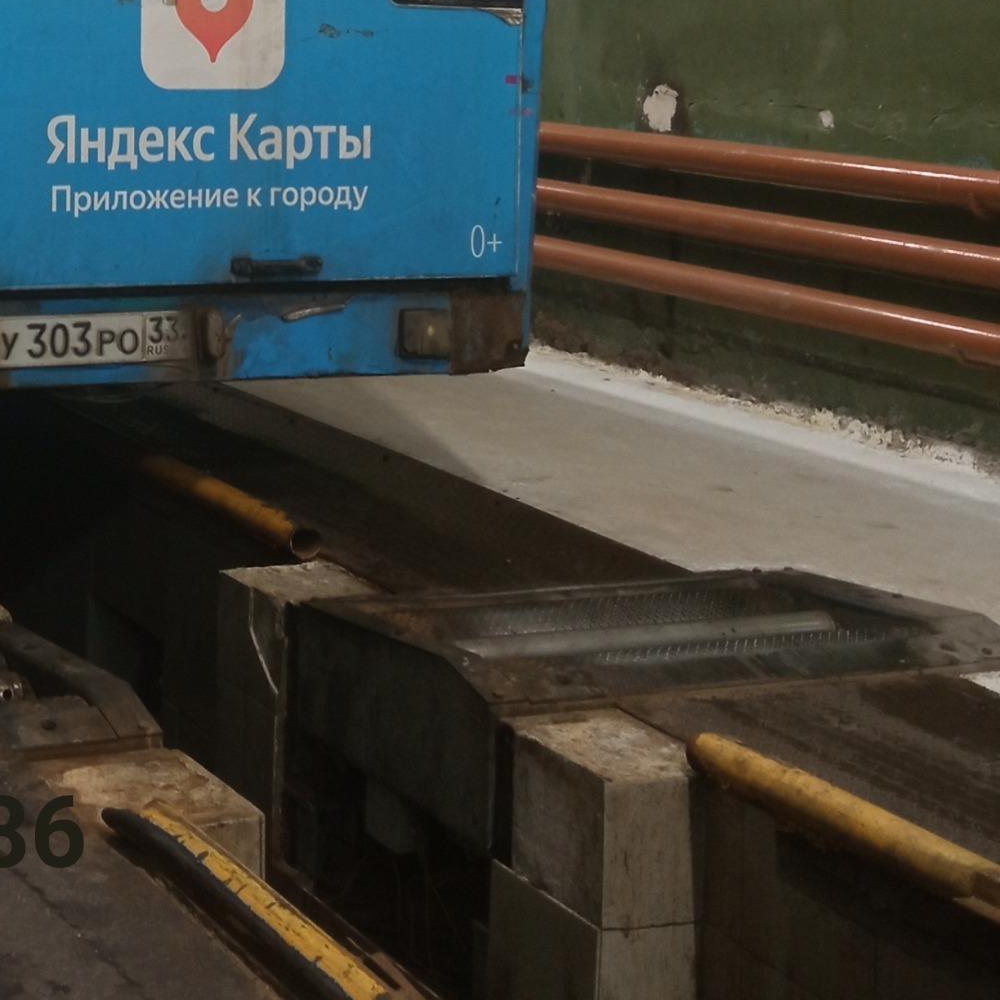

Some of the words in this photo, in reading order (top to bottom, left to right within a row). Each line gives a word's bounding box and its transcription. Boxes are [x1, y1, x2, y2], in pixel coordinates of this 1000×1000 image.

[46, 114, 215, 170] Яндекс
[228, 113, 372, 169] Карты
[51, 184, 239, 217] Приложение
[246, 189, 262, 208] к
[269, 184, 369, 212] городу
[469, 223, 504, 259] 0+
